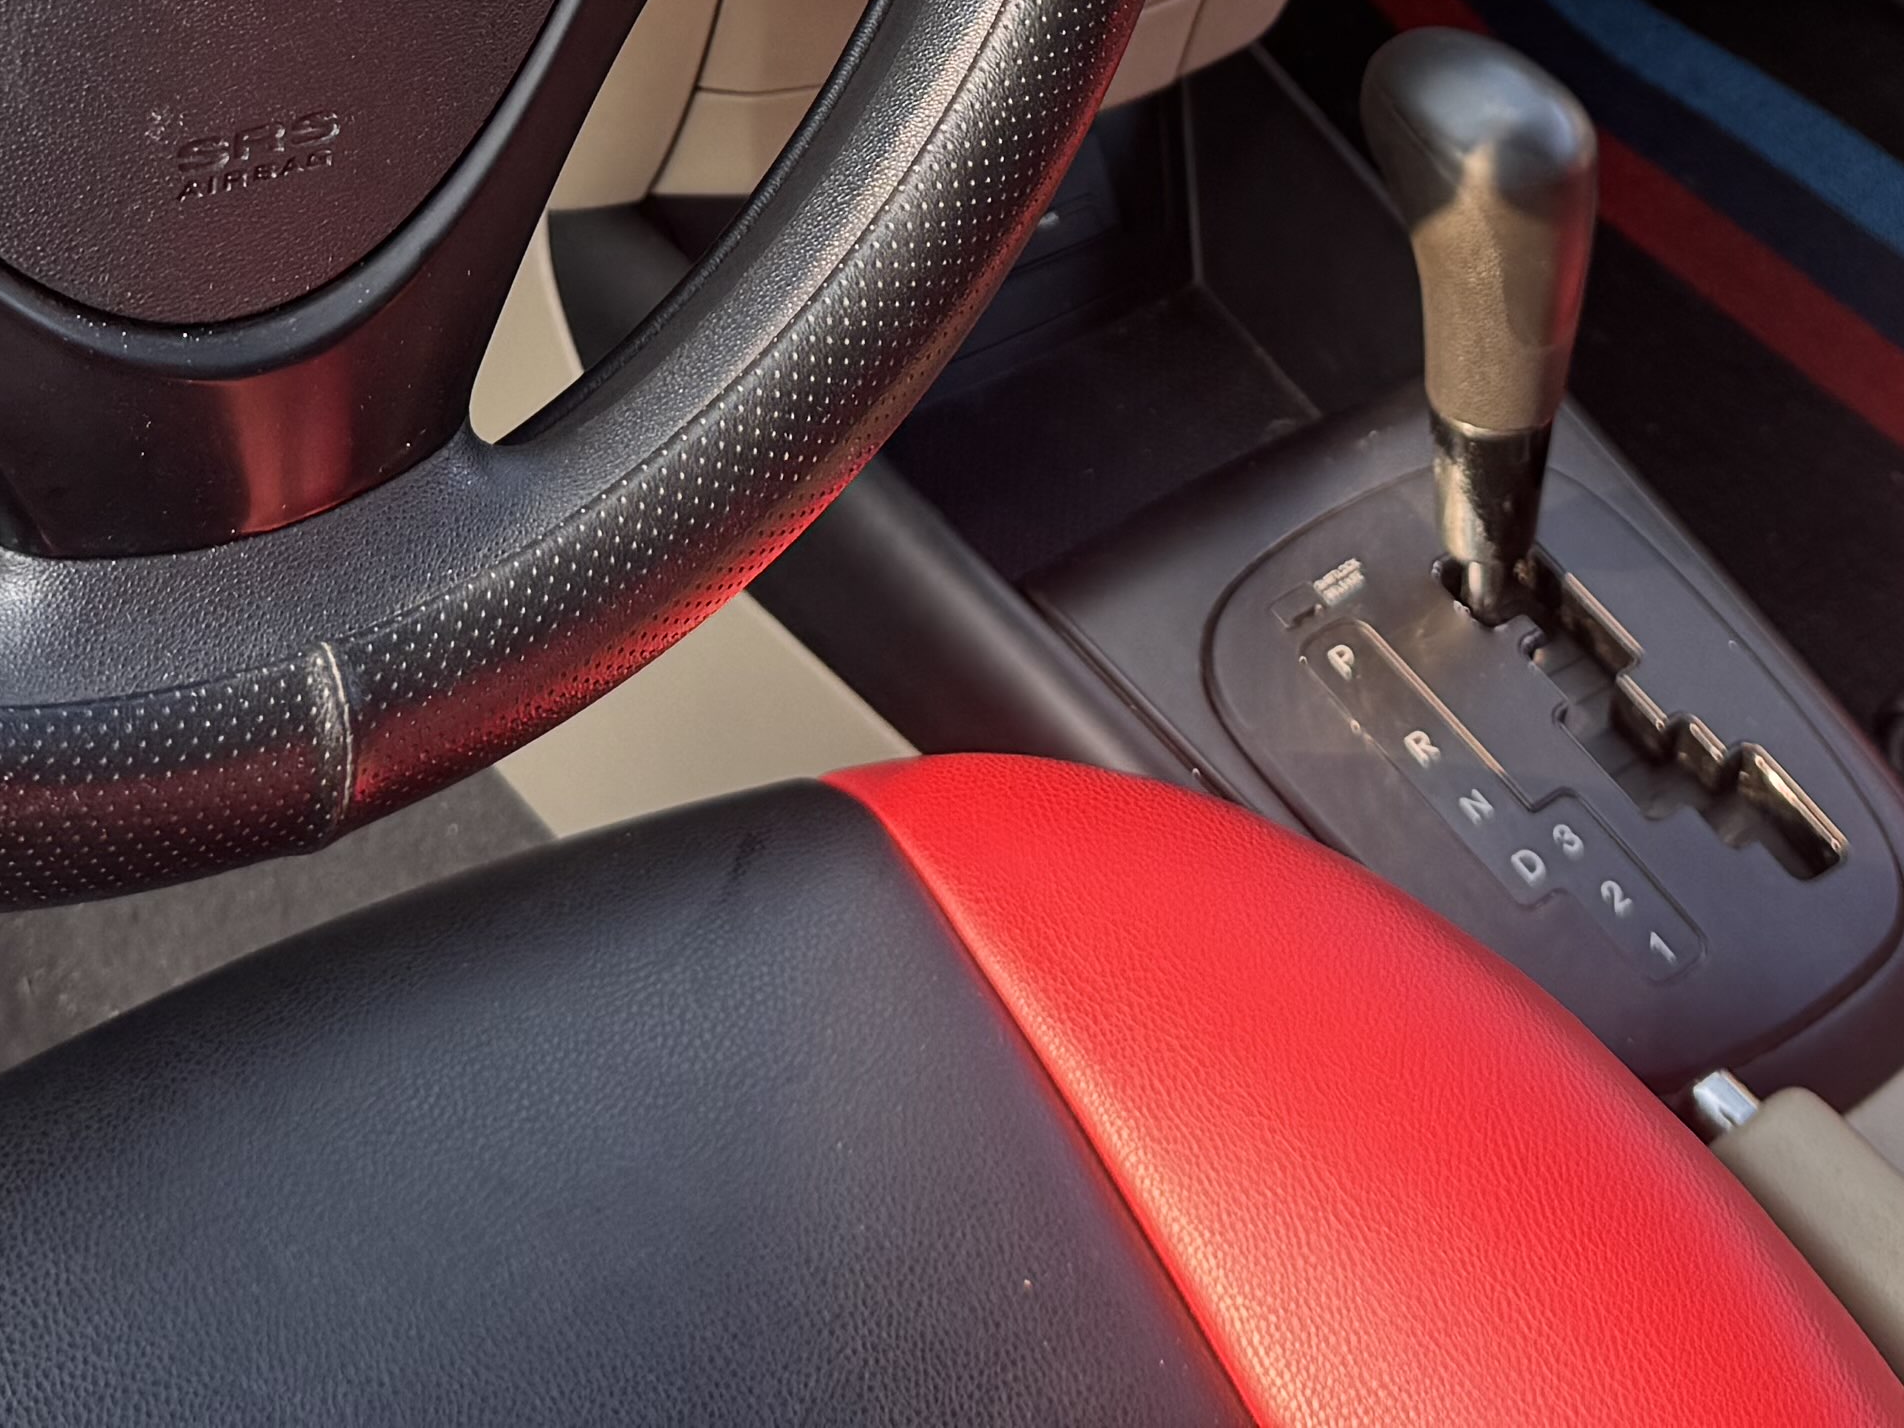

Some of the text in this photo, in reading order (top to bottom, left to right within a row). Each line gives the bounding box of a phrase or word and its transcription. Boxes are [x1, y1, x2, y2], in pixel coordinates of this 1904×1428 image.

[177, 110, 341, 172] SRS
[1327, 644, 1355, 680] P
[1404, 729, 1440, 768] R
[1459, 788, 1494, 825] N
[1552, 824, 1584, 860] 3
[1511, 849, 1546, 886] D
[1600, 880, 1633, 917] 2
[1649, 931, 1678, 964] 1
